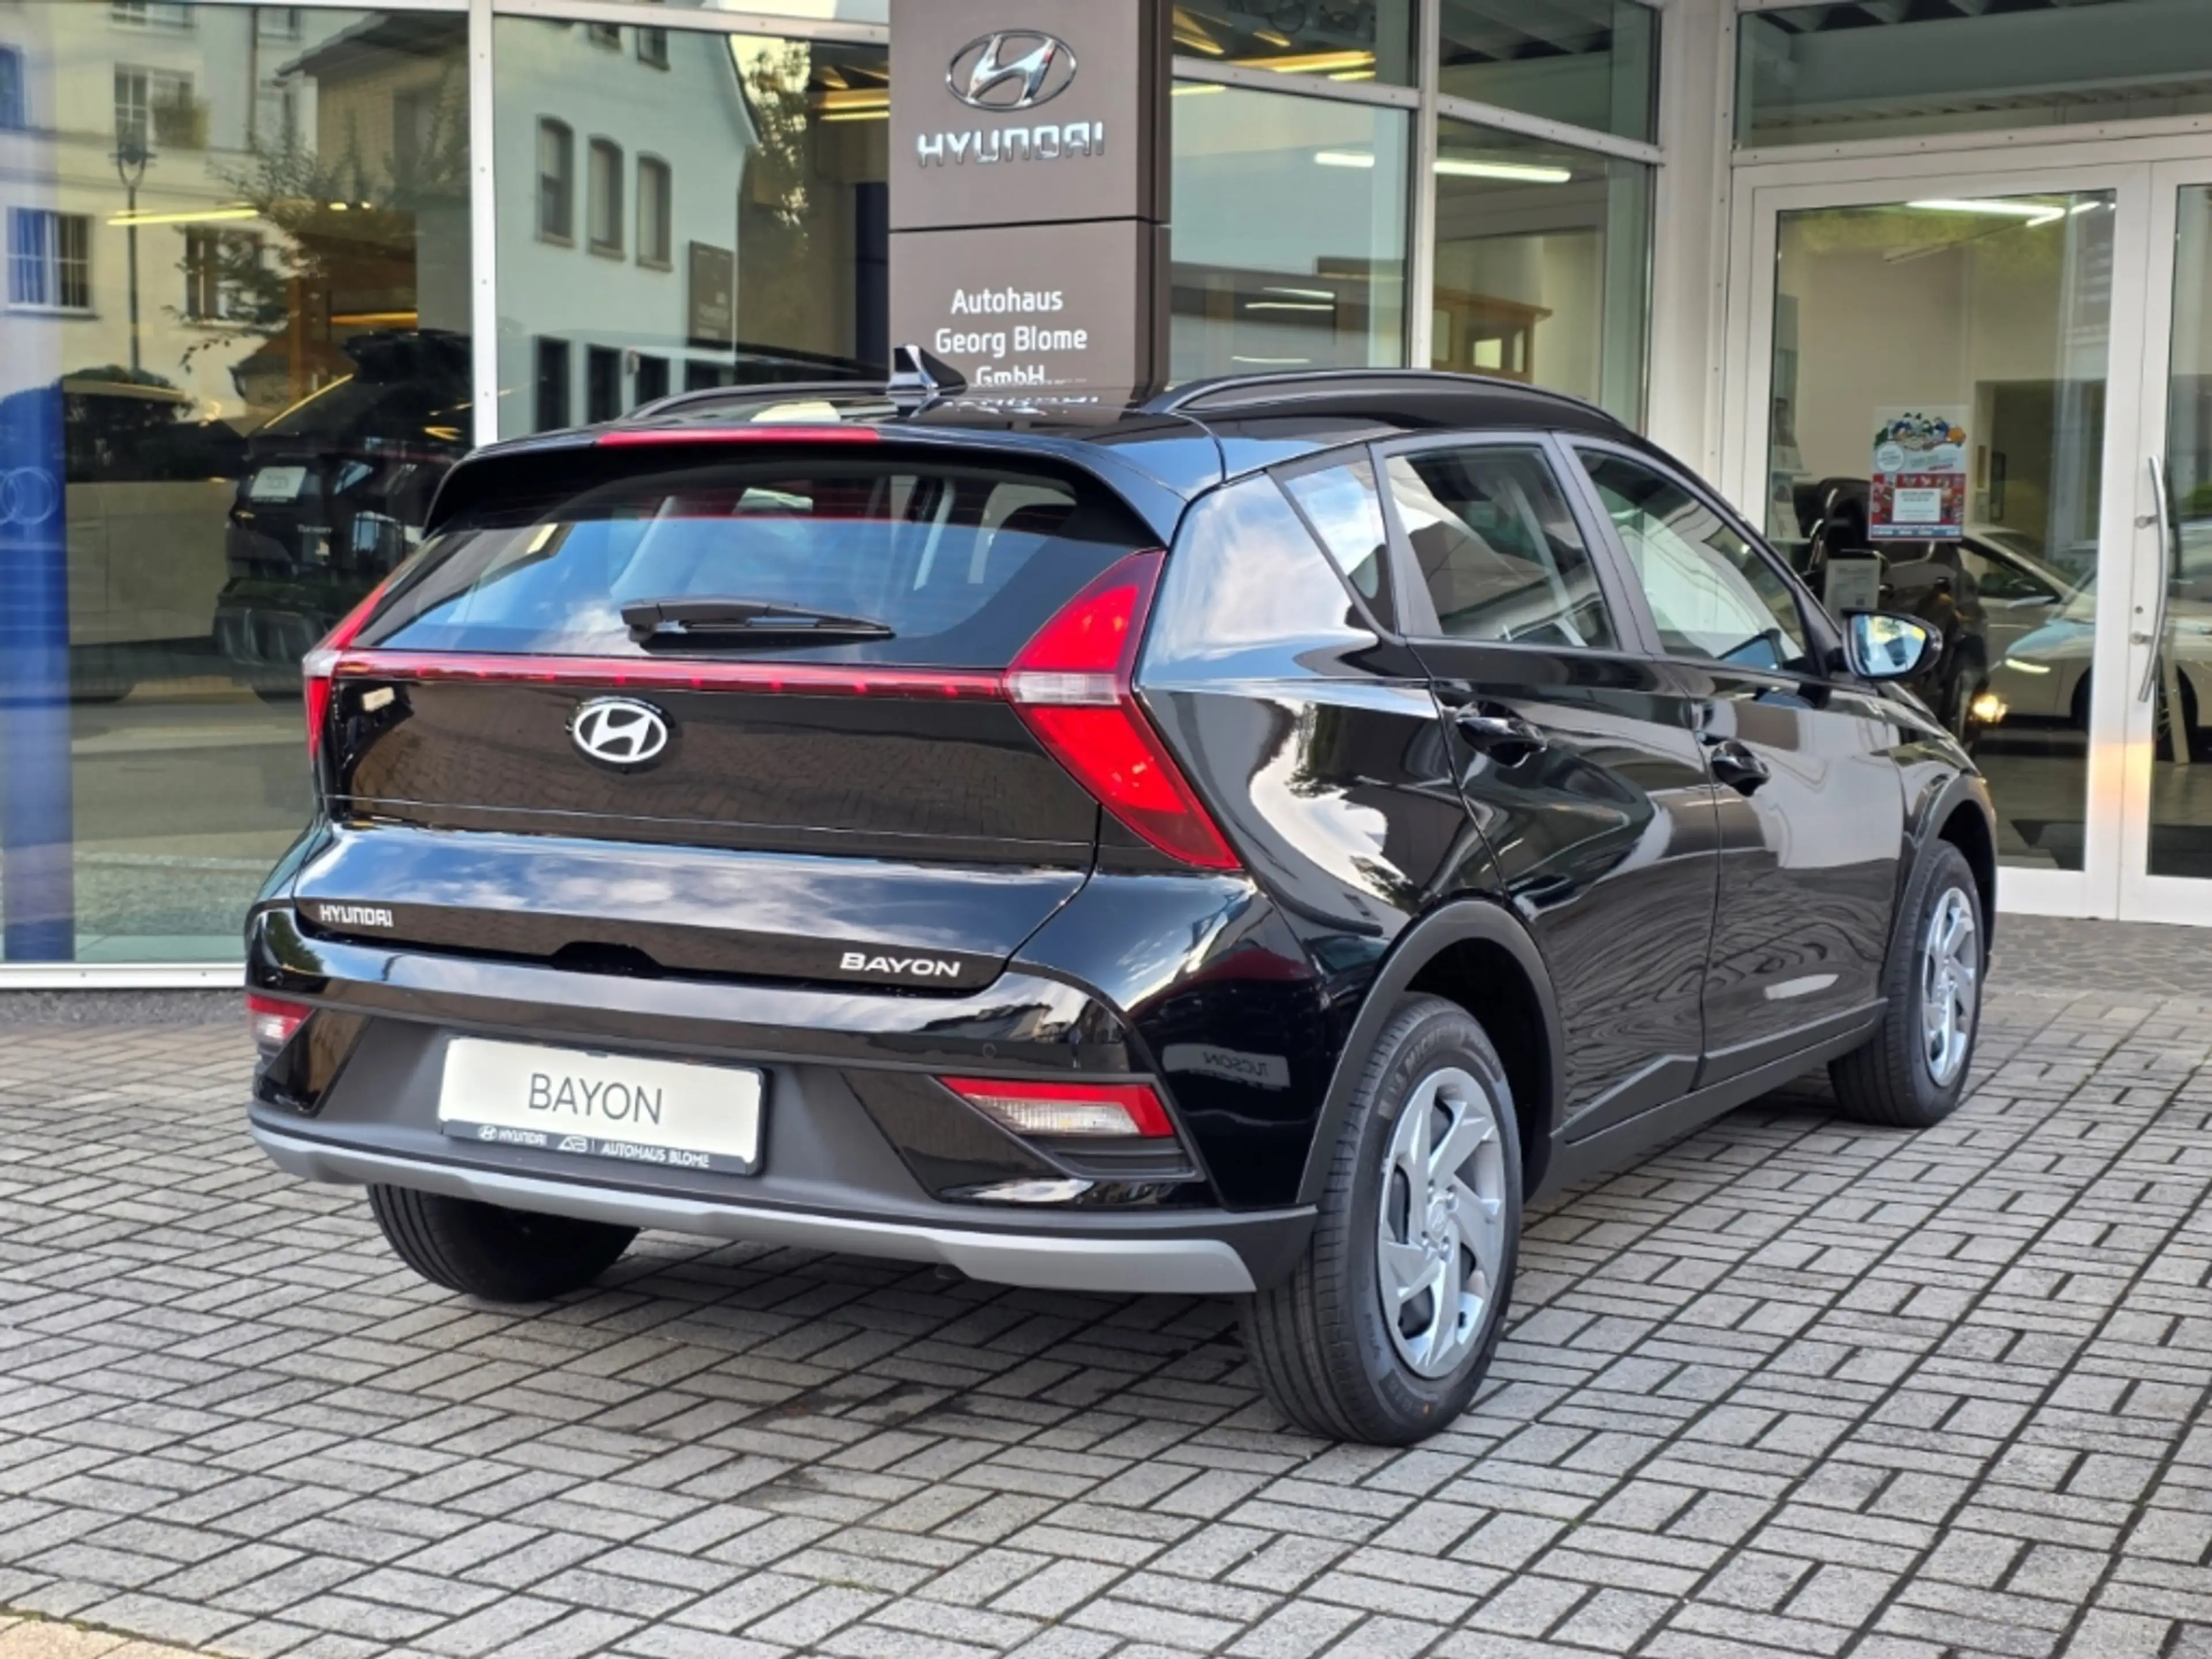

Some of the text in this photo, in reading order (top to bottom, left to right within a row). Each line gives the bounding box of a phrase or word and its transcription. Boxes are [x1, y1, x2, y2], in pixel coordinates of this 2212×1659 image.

[917, 120, 1104, 166] HYUNDAI
[950, 287, 1063, 315] Autohaus
[935, 325, 1088, 358] Georg Blome
[975, 364, 1044, 386] GmbH
[320, 903, 393, 927] HYUNDAI
[840, 952, 960, 978] BAYON
[529, 1072, 662, 1124] BAYON
[499, 1129, 548, 1146] HYUNDAI
[601, 1142, 666, 1162] AUTOHAUS
[669, 1149, 710, 1168] BLOME
